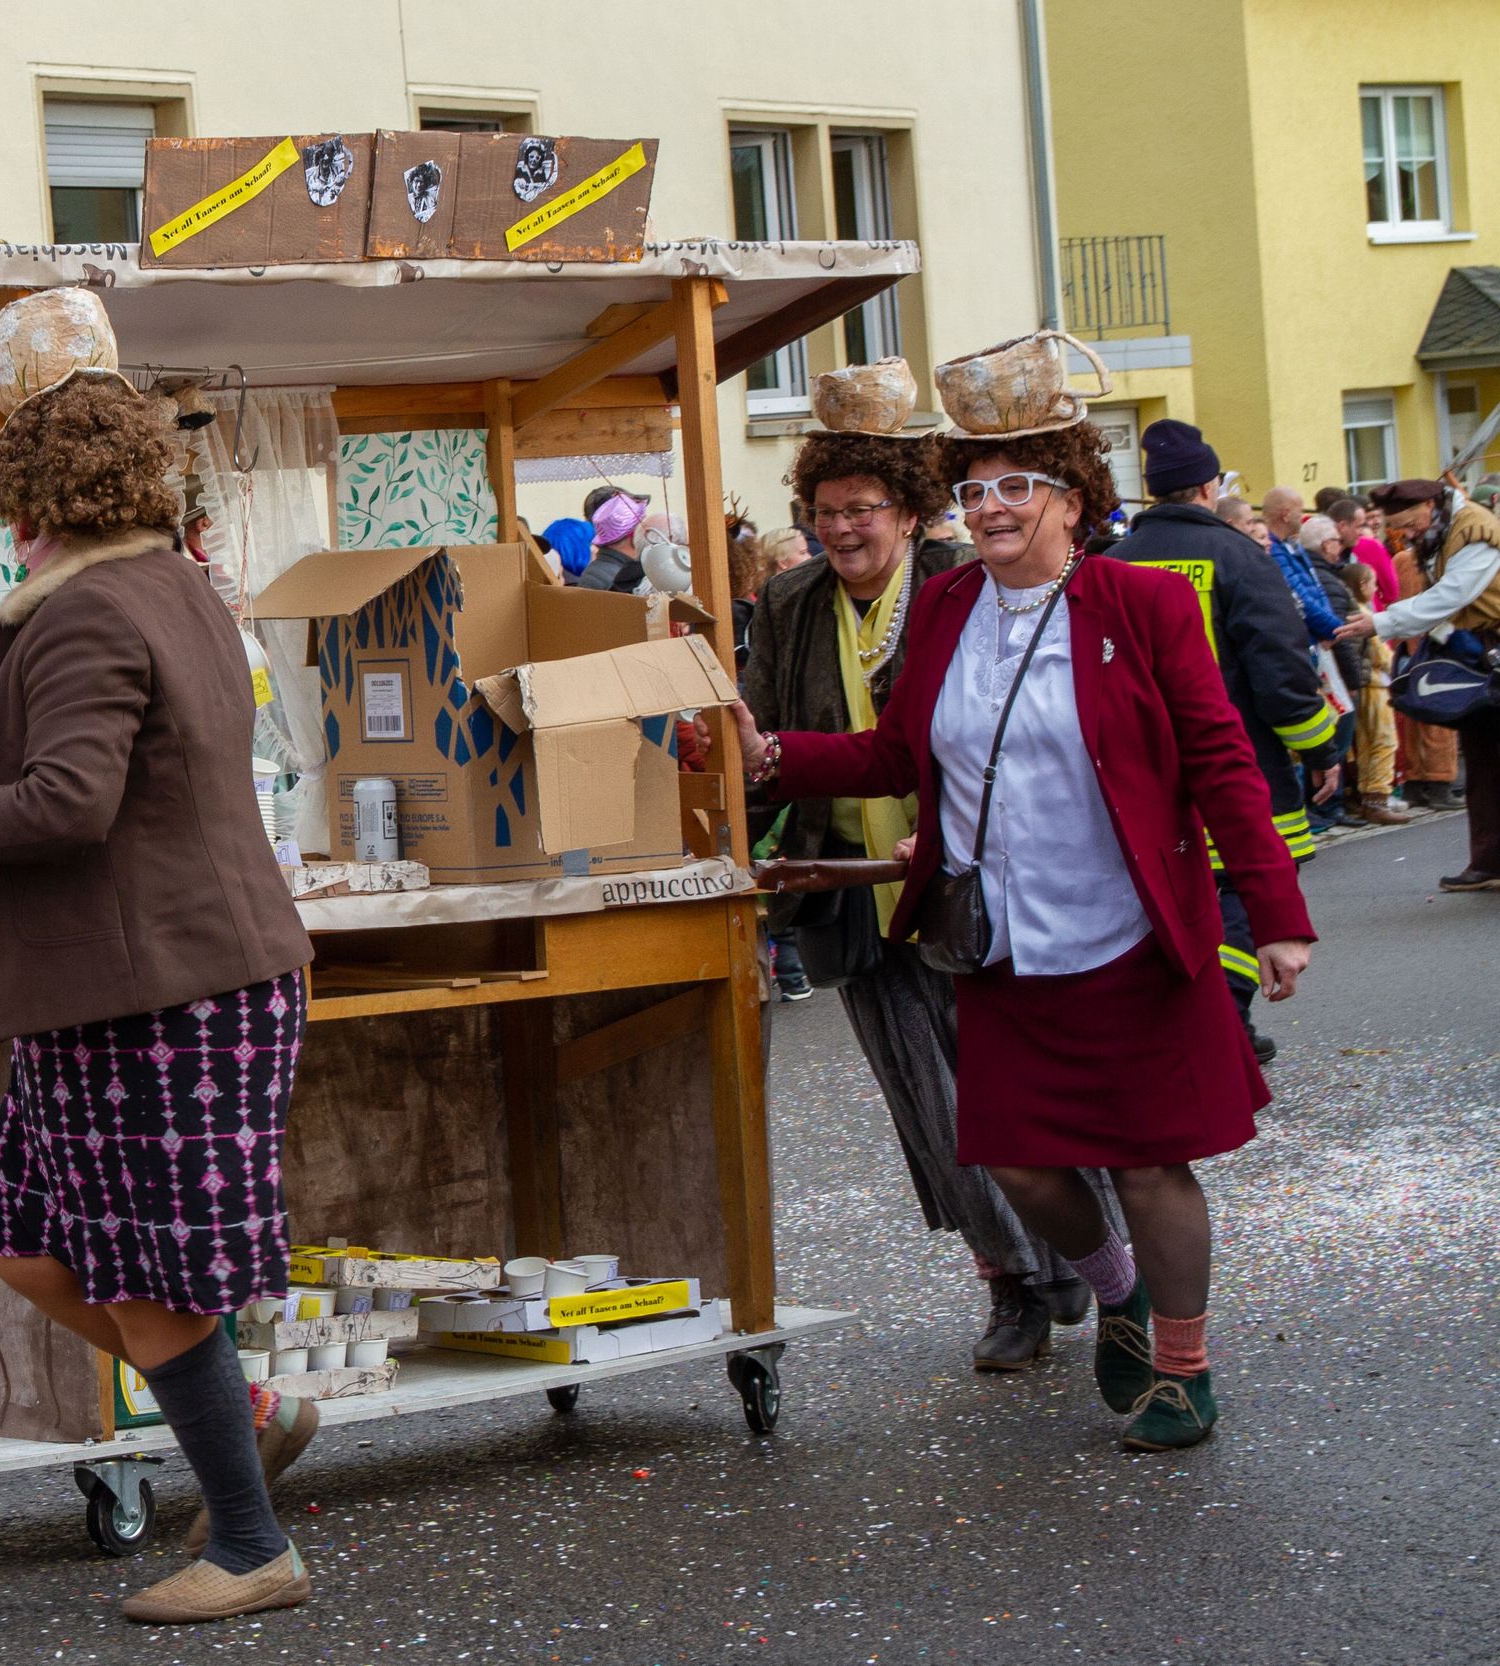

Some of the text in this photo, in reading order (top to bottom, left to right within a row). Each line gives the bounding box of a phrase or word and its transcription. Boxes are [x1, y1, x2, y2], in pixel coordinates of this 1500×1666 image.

[161, 162, 272, 242] Net all Taasen am Schaaf?
[516, 167, 621, 237] Net all Taasen am Schaaf?
[1301, 462, 1317, 482] 27
[560, 1295, 664, 1318] Net all Taasen am Schaaf?
